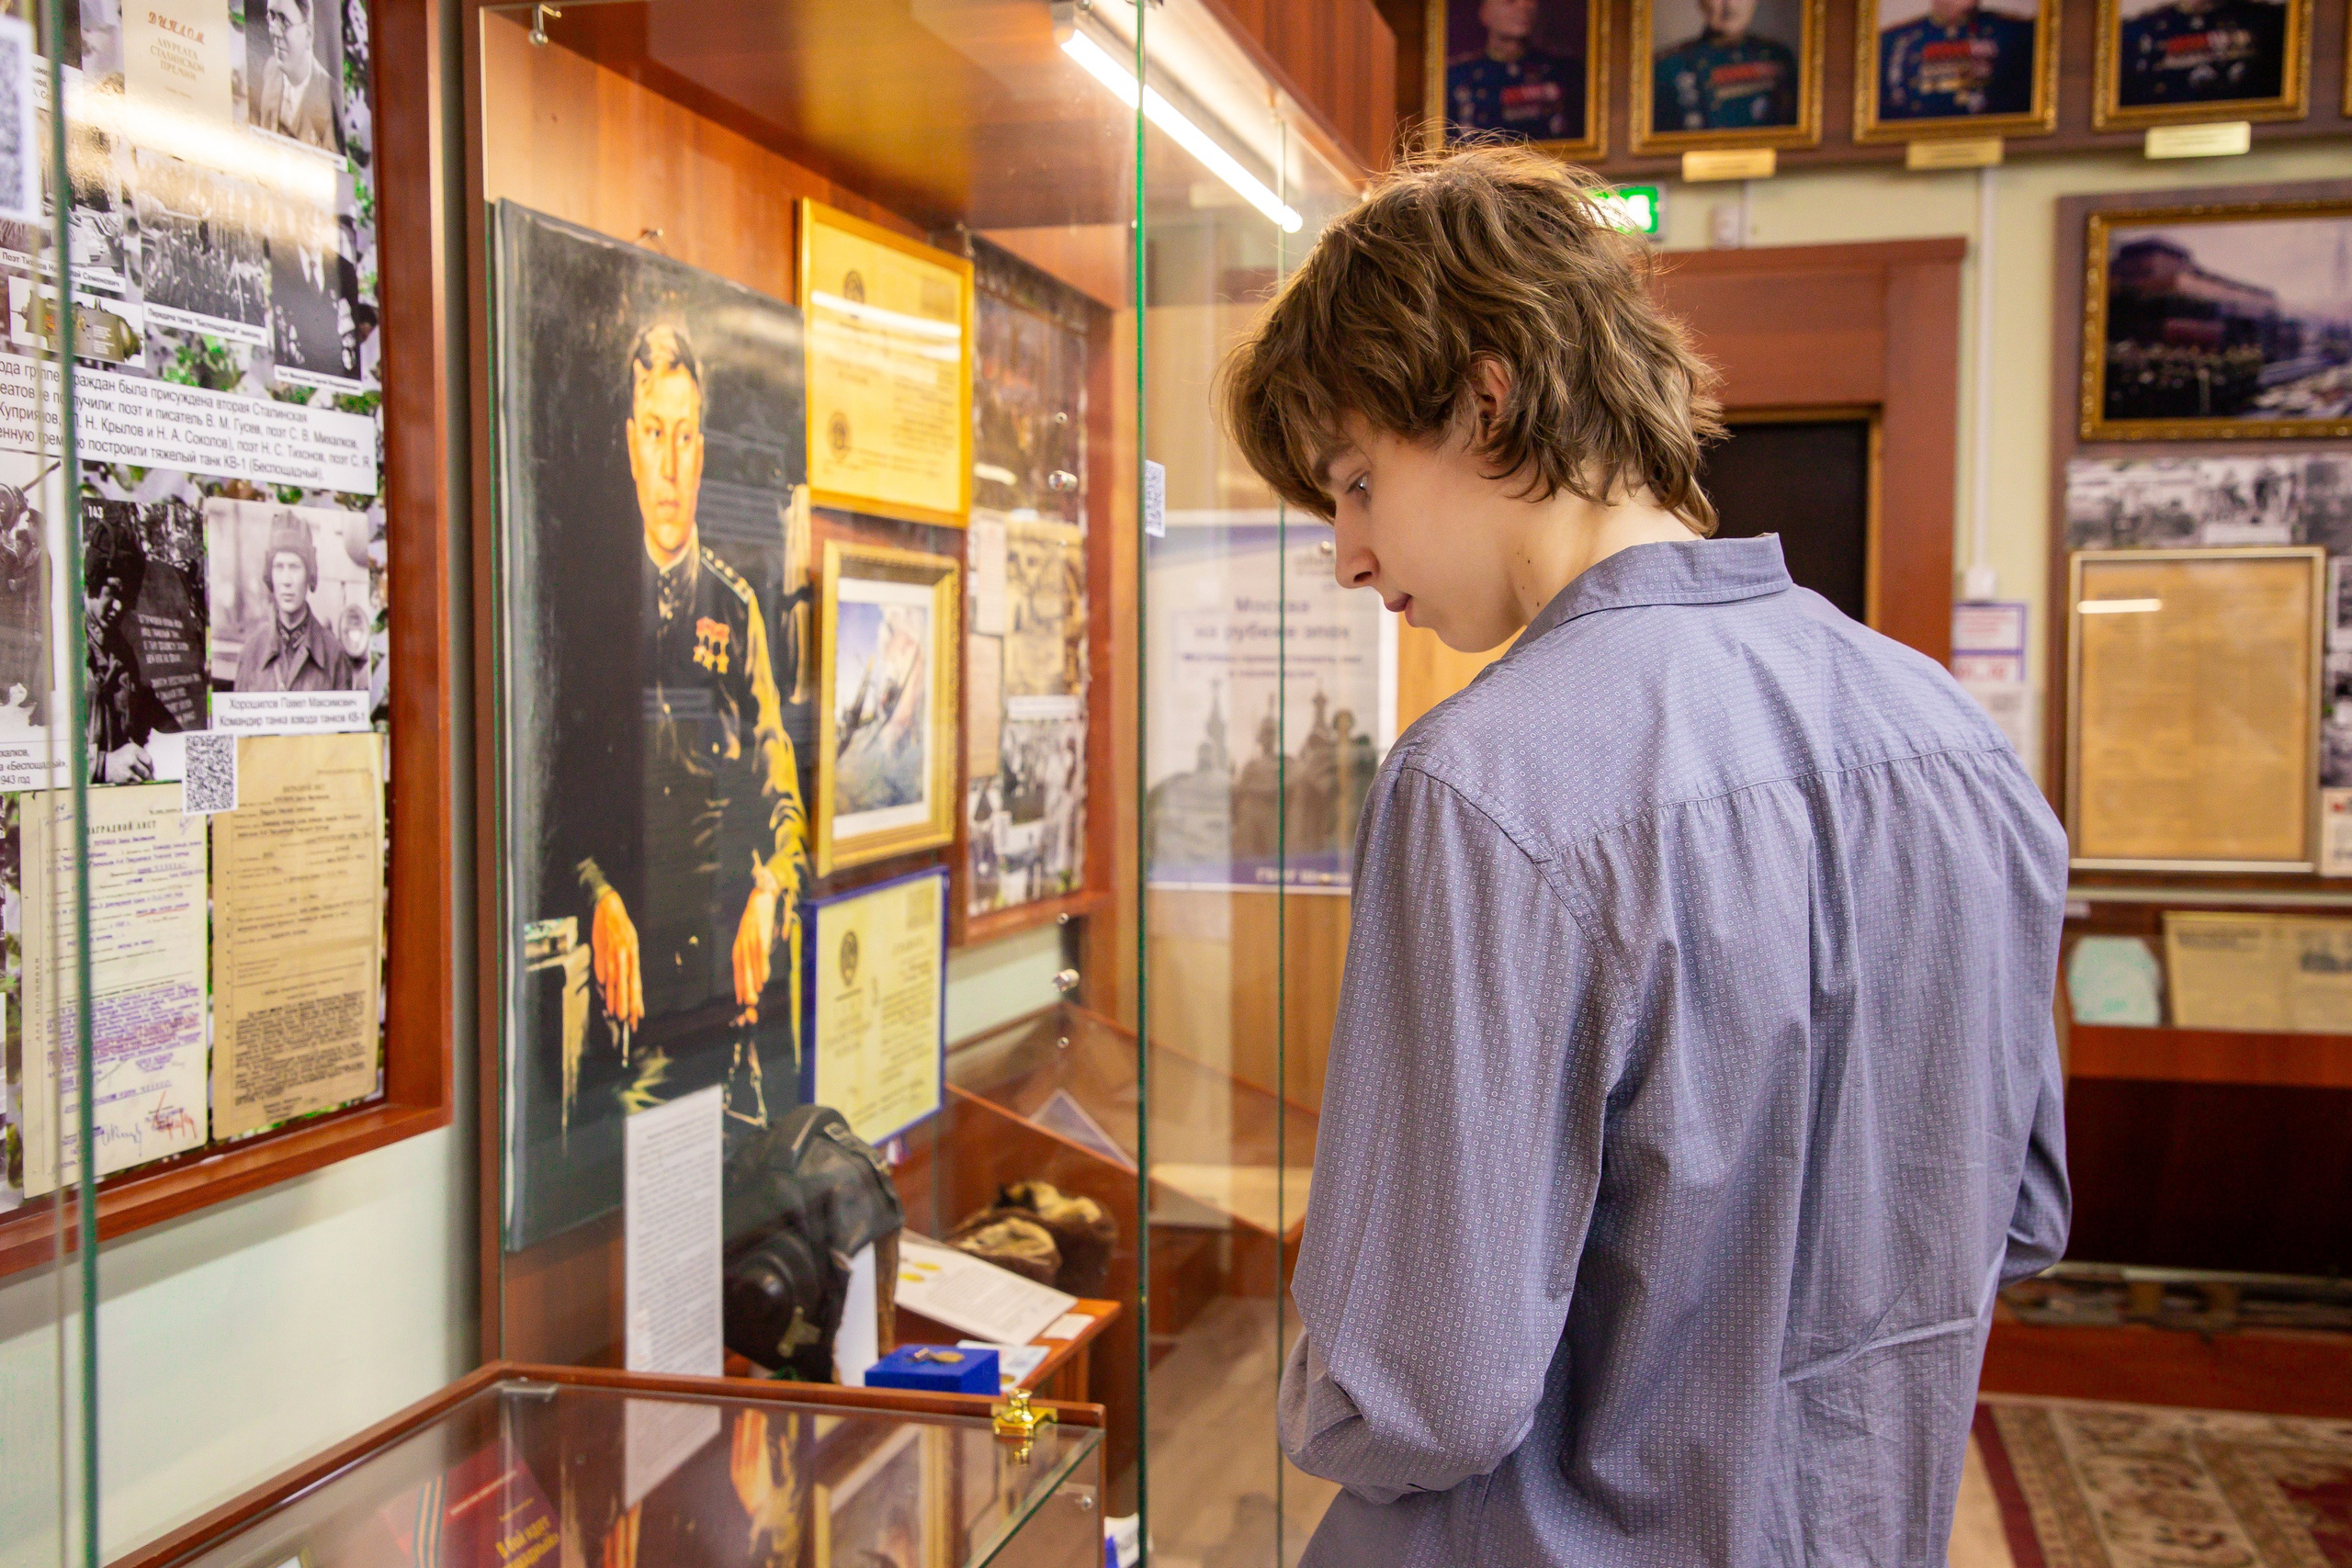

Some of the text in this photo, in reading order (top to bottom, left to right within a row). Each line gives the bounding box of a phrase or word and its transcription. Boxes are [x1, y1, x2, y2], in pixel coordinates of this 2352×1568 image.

[148, 11, 206, 45] ДИПЛОМ
[3, 251, 19, 264] Поэт
[25, 365, 60, 383] грппе
[73, 374, 114, 391] раждан
[119, 379, 147, 397] была
[151, 388, 213, 408] присуждена
[216, 399, 250, 413] вторая
[252, 402, 307, 423] Сталинская
[0, 382, 35, 399] еатов
[119, 402, 142, 416] поэт
[146, 407, 153, 417] и
[155, 408, 203, 426] писатель
[206, 413, 216, 428] В.
[219, 415, 230, 430] М.
[234, 417, 263, 435] Гусев,
[266, 425, 286, 438] поэт
[288, 426, 298, 441] С.
[301, 428, 311, 442] В.
[313, 430, 358, 450] Михалков,
[0, 401, 62, 427] Куприяов,
[85, 414, 97, 431] Н.
[101, 417, 143, 435] Крылов
[147, 427, 153, 438] и
[156, 425, 168, 441] Н.
[171, 428, 181, 443] А.
[185, 430, 233, 451] Соколов),
[237, 441, 258, 452] поэт
[261, 441, 271, 455] Н.
[274, 443, 282, 457] С.
[288, 445, 327, 463] Тихонов,
[329, 455, 348, 465] поэт
[350, 454, 359, 468] С.
[88, 439, 147, 457] построили
[151, 448, 197, 462] тяжелый
[199, 455, 220, 467] танк
[223, 455, 245, 469] КВ-1
[87, 505, 104, 519] 143
[229, 697, 356, 711] Хорошилов Павел Максимович
[220, 716, 262, 727] Командир
[266, 716, 288, 725] танка
[18, 776, 30, 784] год
